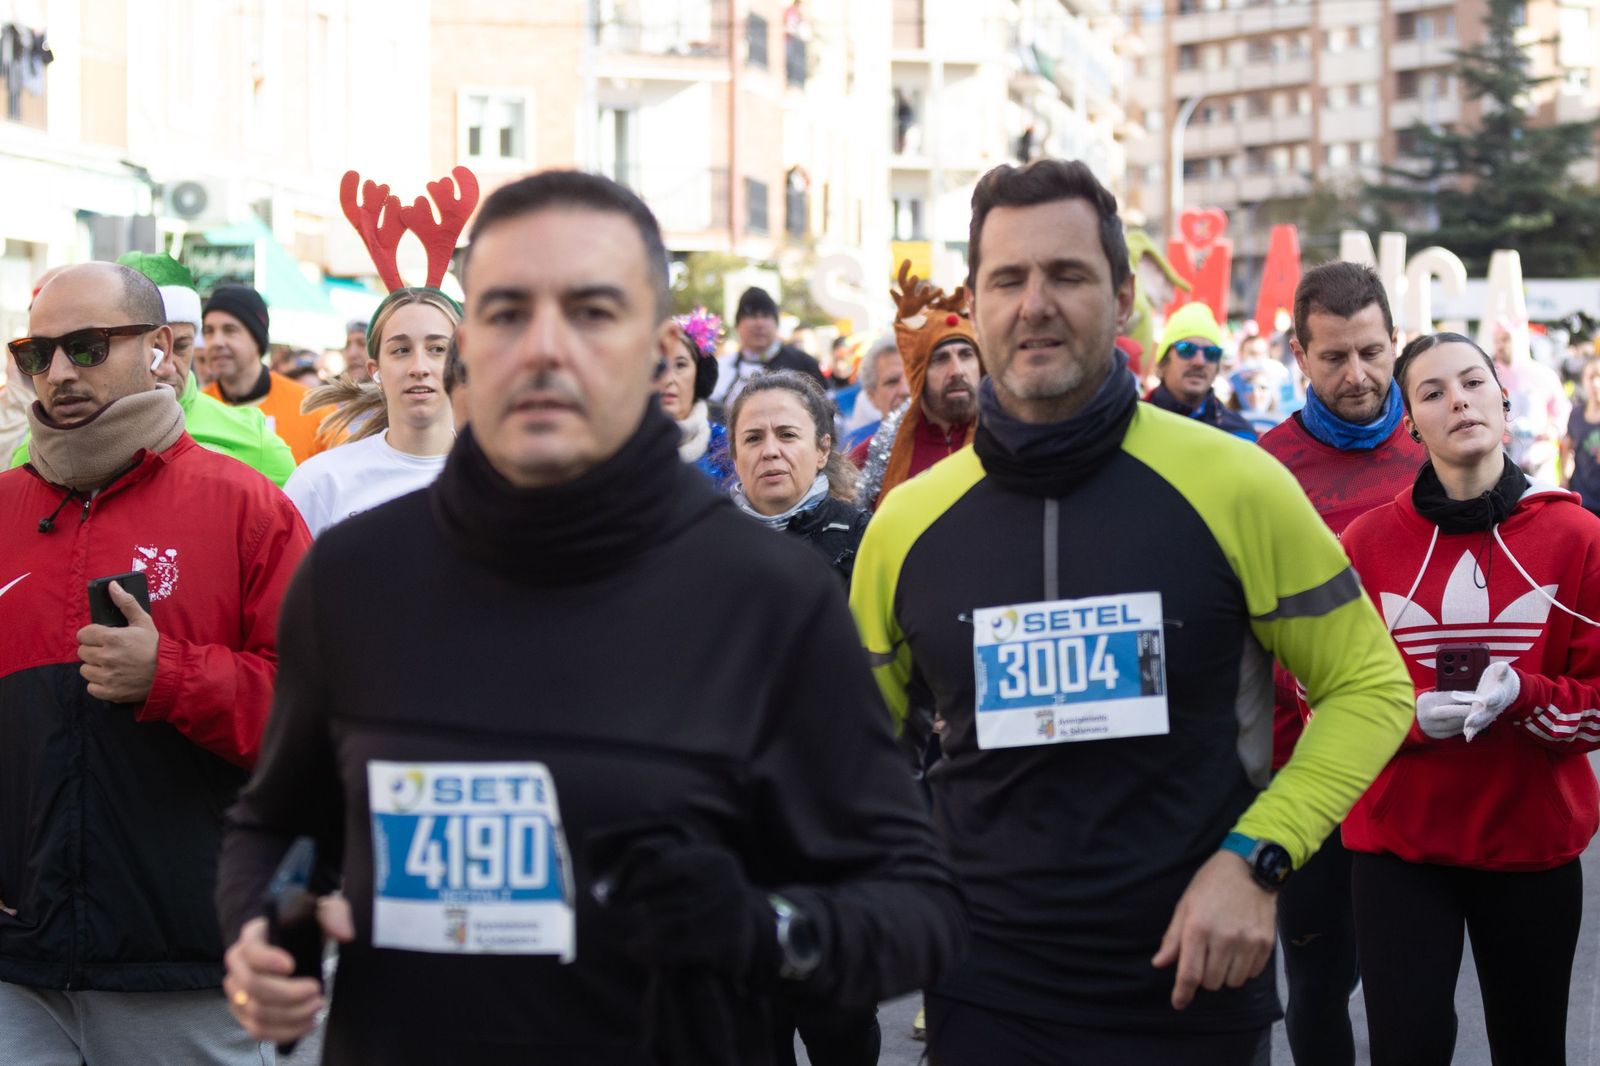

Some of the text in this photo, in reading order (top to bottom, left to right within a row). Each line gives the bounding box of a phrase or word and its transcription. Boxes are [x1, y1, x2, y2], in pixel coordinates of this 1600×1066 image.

[1023, 604, 1141, 634] SETEL
[997, 634, 1120, 700] 3004
[404, 815, 550, 891] 4190
